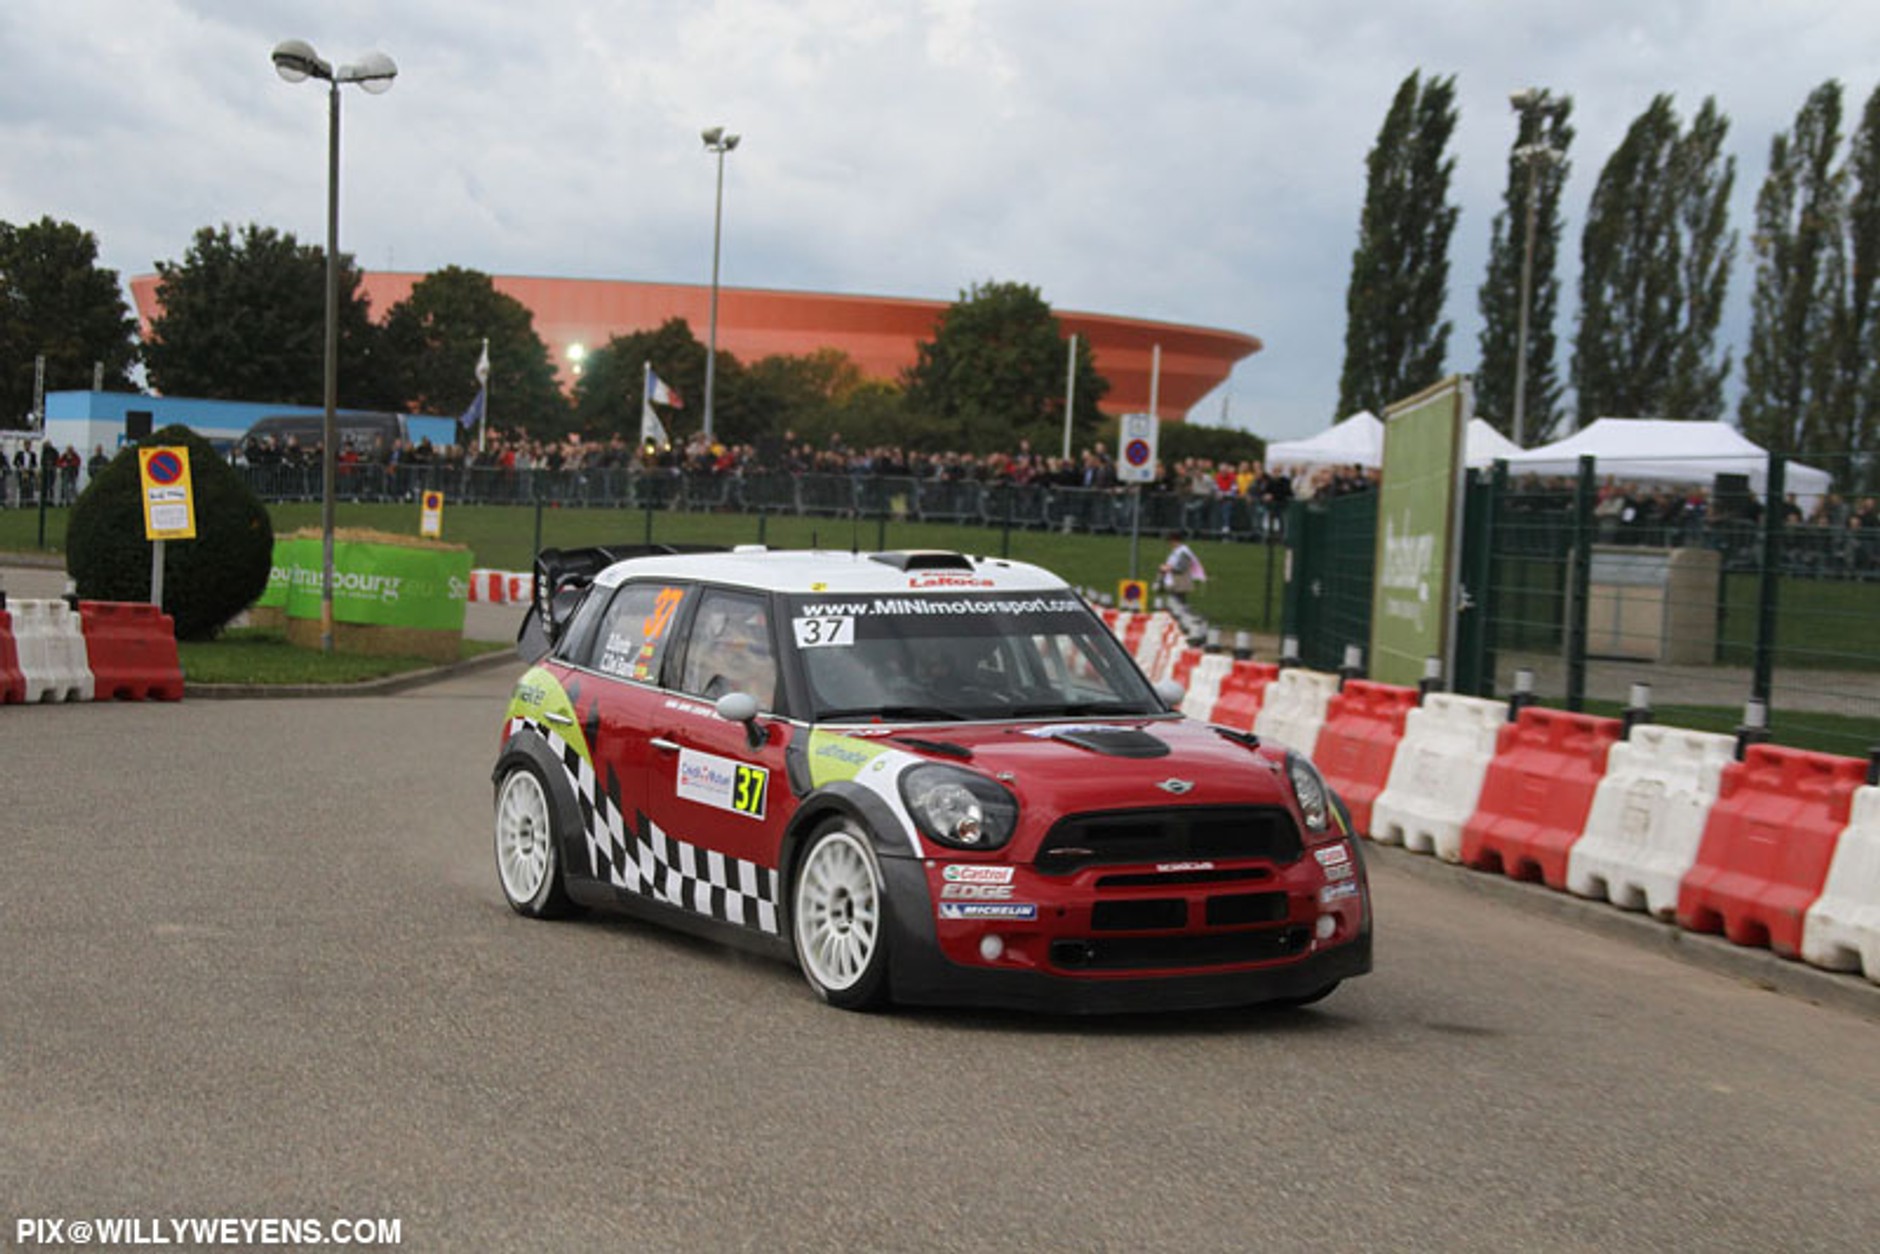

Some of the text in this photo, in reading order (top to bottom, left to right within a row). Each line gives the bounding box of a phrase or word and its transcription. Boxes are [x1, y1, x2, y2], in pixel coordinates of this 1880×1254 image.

[643, 586, 684, 640] 37
[803, 619, 843, 644] 37
[735, 766, 766, 814] 37
[961, 867, 1009, 880] Castrol
[941, 884, 1016, 899] EDGE
[963, 905, 1034, 916] MICHELIN
